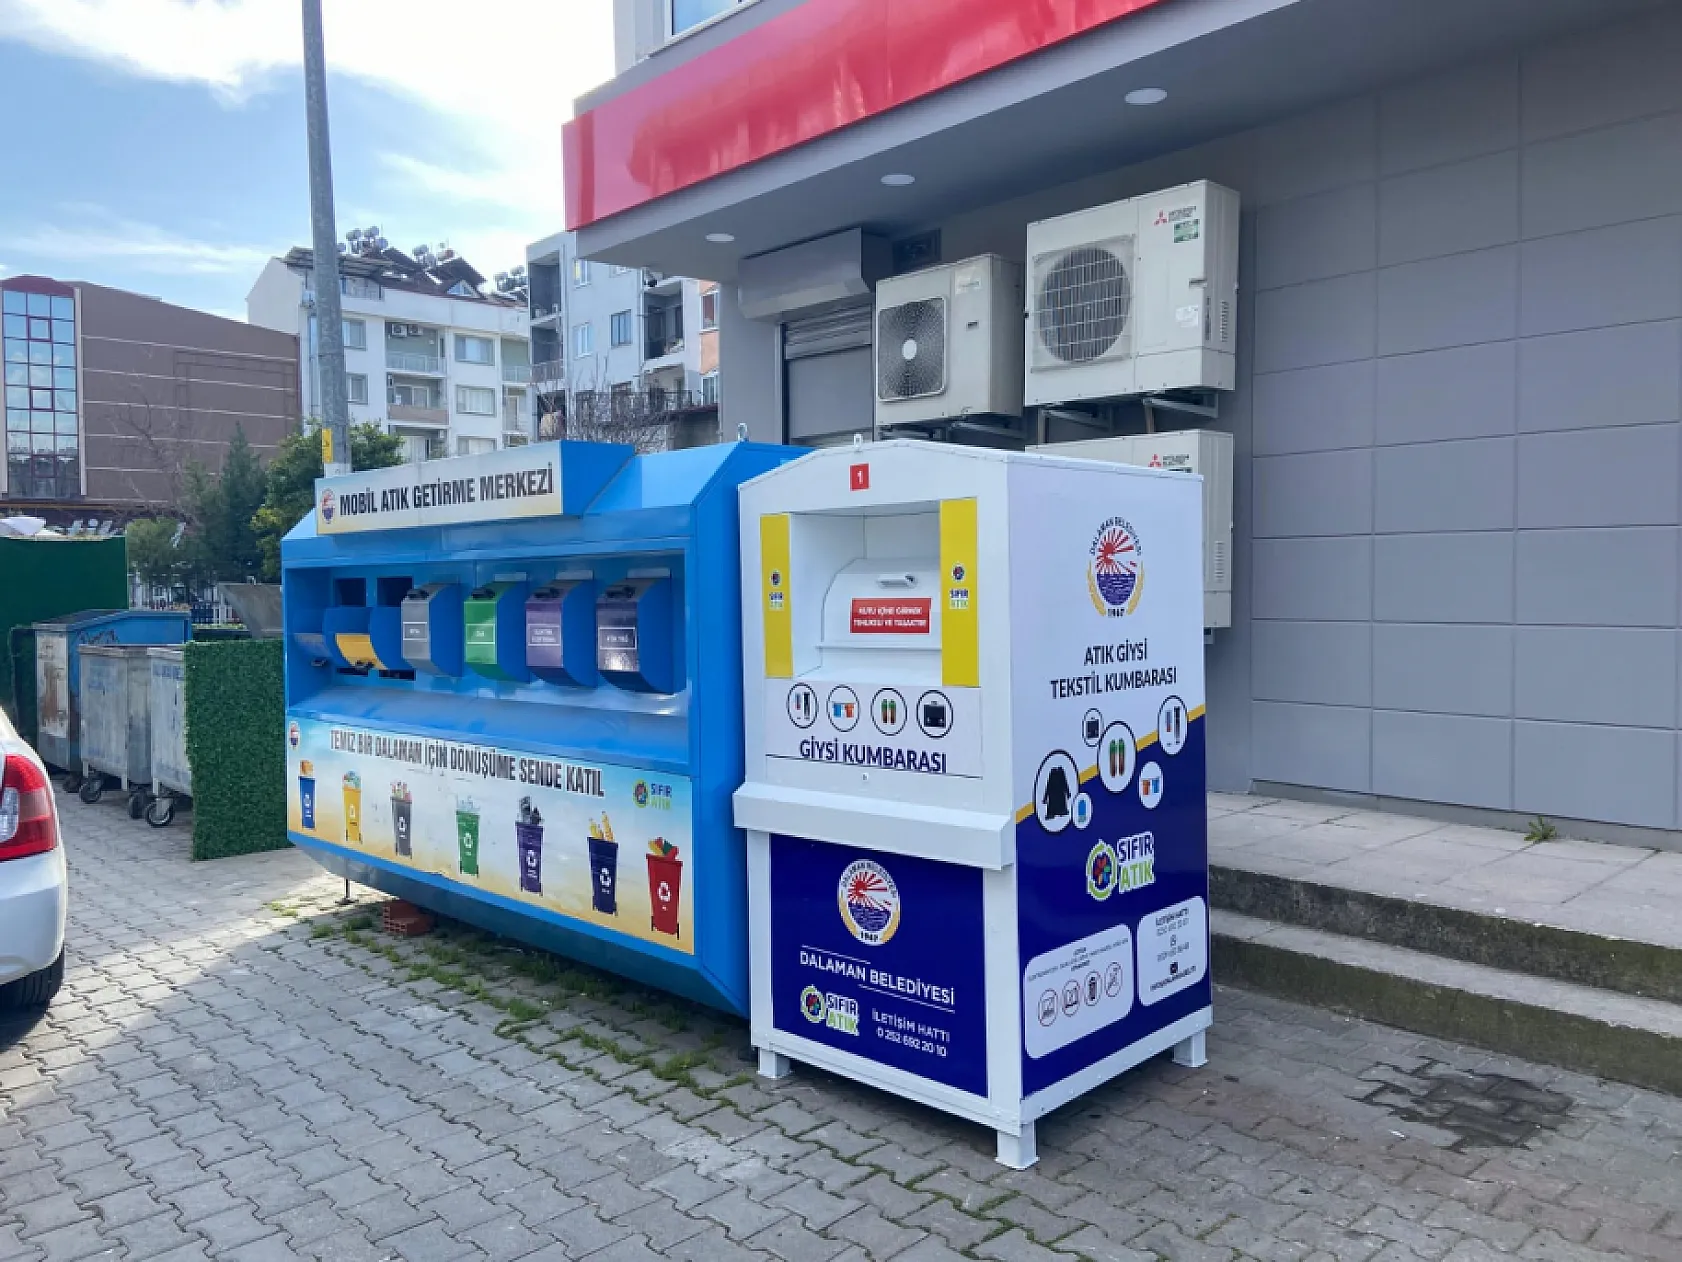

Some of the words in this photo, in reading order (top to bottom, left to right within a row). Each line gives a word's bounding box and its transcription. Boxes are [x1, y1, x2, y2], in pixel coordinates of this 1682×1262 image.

[340, 487, 378, 516] MOBİL
[380, 486, 410, 512] ATIK
[413, 477, 475, 509] GETİRME
[479, 462, 554, 501] MERKEZİ
[856, 470, 864, 485] 1
[1084, 644, 1115, 666] ATIK
[1116, 638, 1148, 663] GİYSİ
[1050, 671, 1103, 699] TEKSTİL
[1105, 666, 1177, 693] KUMBARASI
[375, 735, 422, 764] DALAMAN
[450, 744, 516, 781] DÖNÜŞÜME
[519, 757, 562, 789] SENDE
[566, 765, 605, 798] KATIL
[799, 735, 838, 761] GİYSİ
[842, 742, 947, 774] KUMBARASI
[1118, 831, 1154, 863] SIFIR
[1119, 861, 1154, 891] ATIK
[800, 951, 866, 981] DALAMAN
[869, 969, 955, 1005] BELEDİYESİ
[826, 993, 858, 1016] SIFIR
[877, 1026, 884, 1038] 0
[918, 1022, 950, 1043] HATTI
